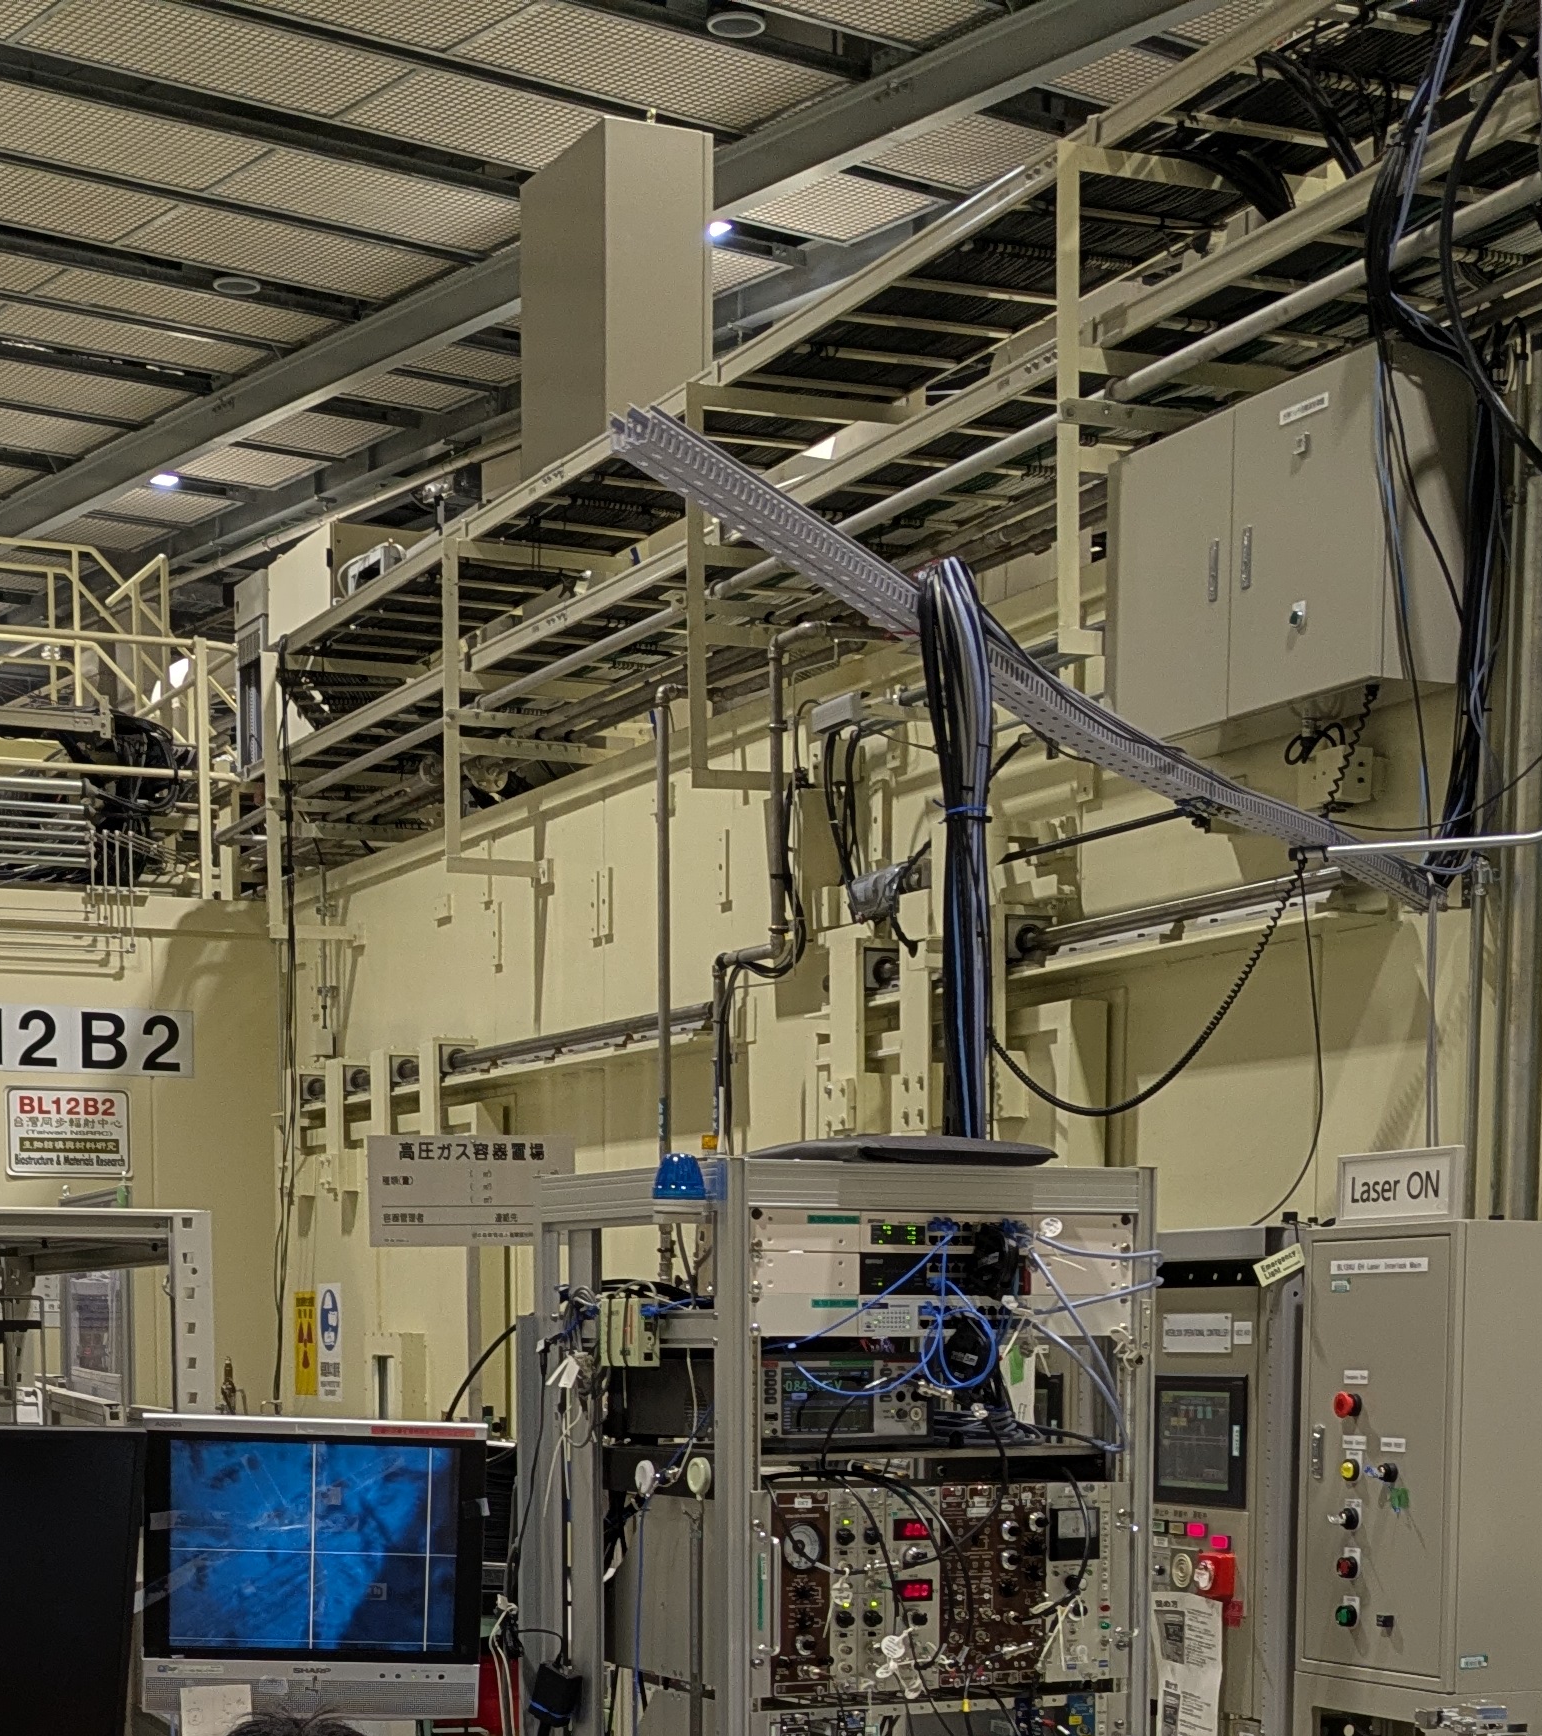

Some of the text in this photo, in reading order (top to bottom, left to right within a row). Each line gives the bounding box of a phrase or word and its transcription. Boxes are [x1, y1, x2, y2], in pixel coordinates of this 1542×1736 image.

[19, 1095, 116, 1117] BL12B2
[398, 1142, 545, 1161] 高圧ガス容器置場
[1350, 1169, 1441, 1204] Laser ON
[1260, 1249, 1297, 1273] Emergency
